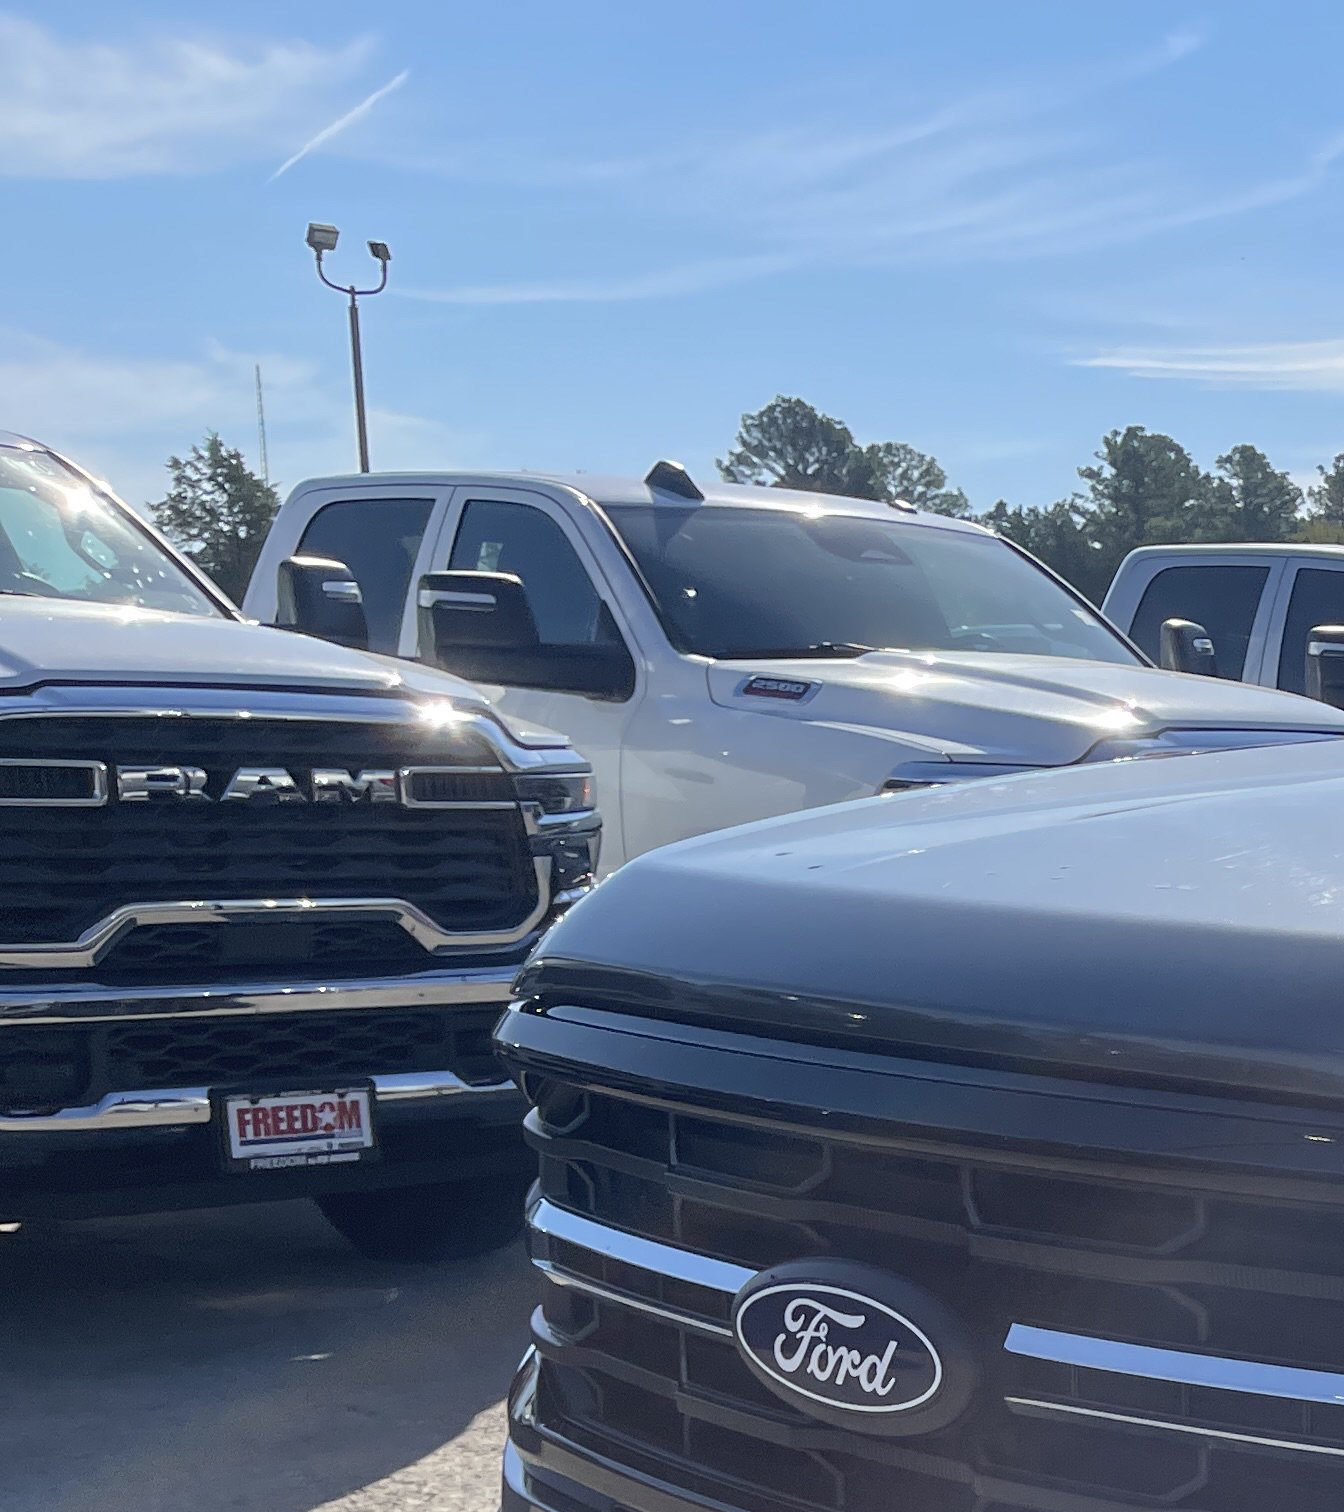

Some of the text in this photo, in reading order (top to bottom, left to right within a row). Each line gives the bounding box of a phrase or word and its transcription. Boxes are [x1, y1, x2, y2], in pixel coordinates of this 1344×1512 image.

[751, 678, 806, 694] 2500
[116, 765, 398, 802] RAM
[237, 1100, 362, 1138] FREEDOM
[774, 1297, 898, 1396] Ford
